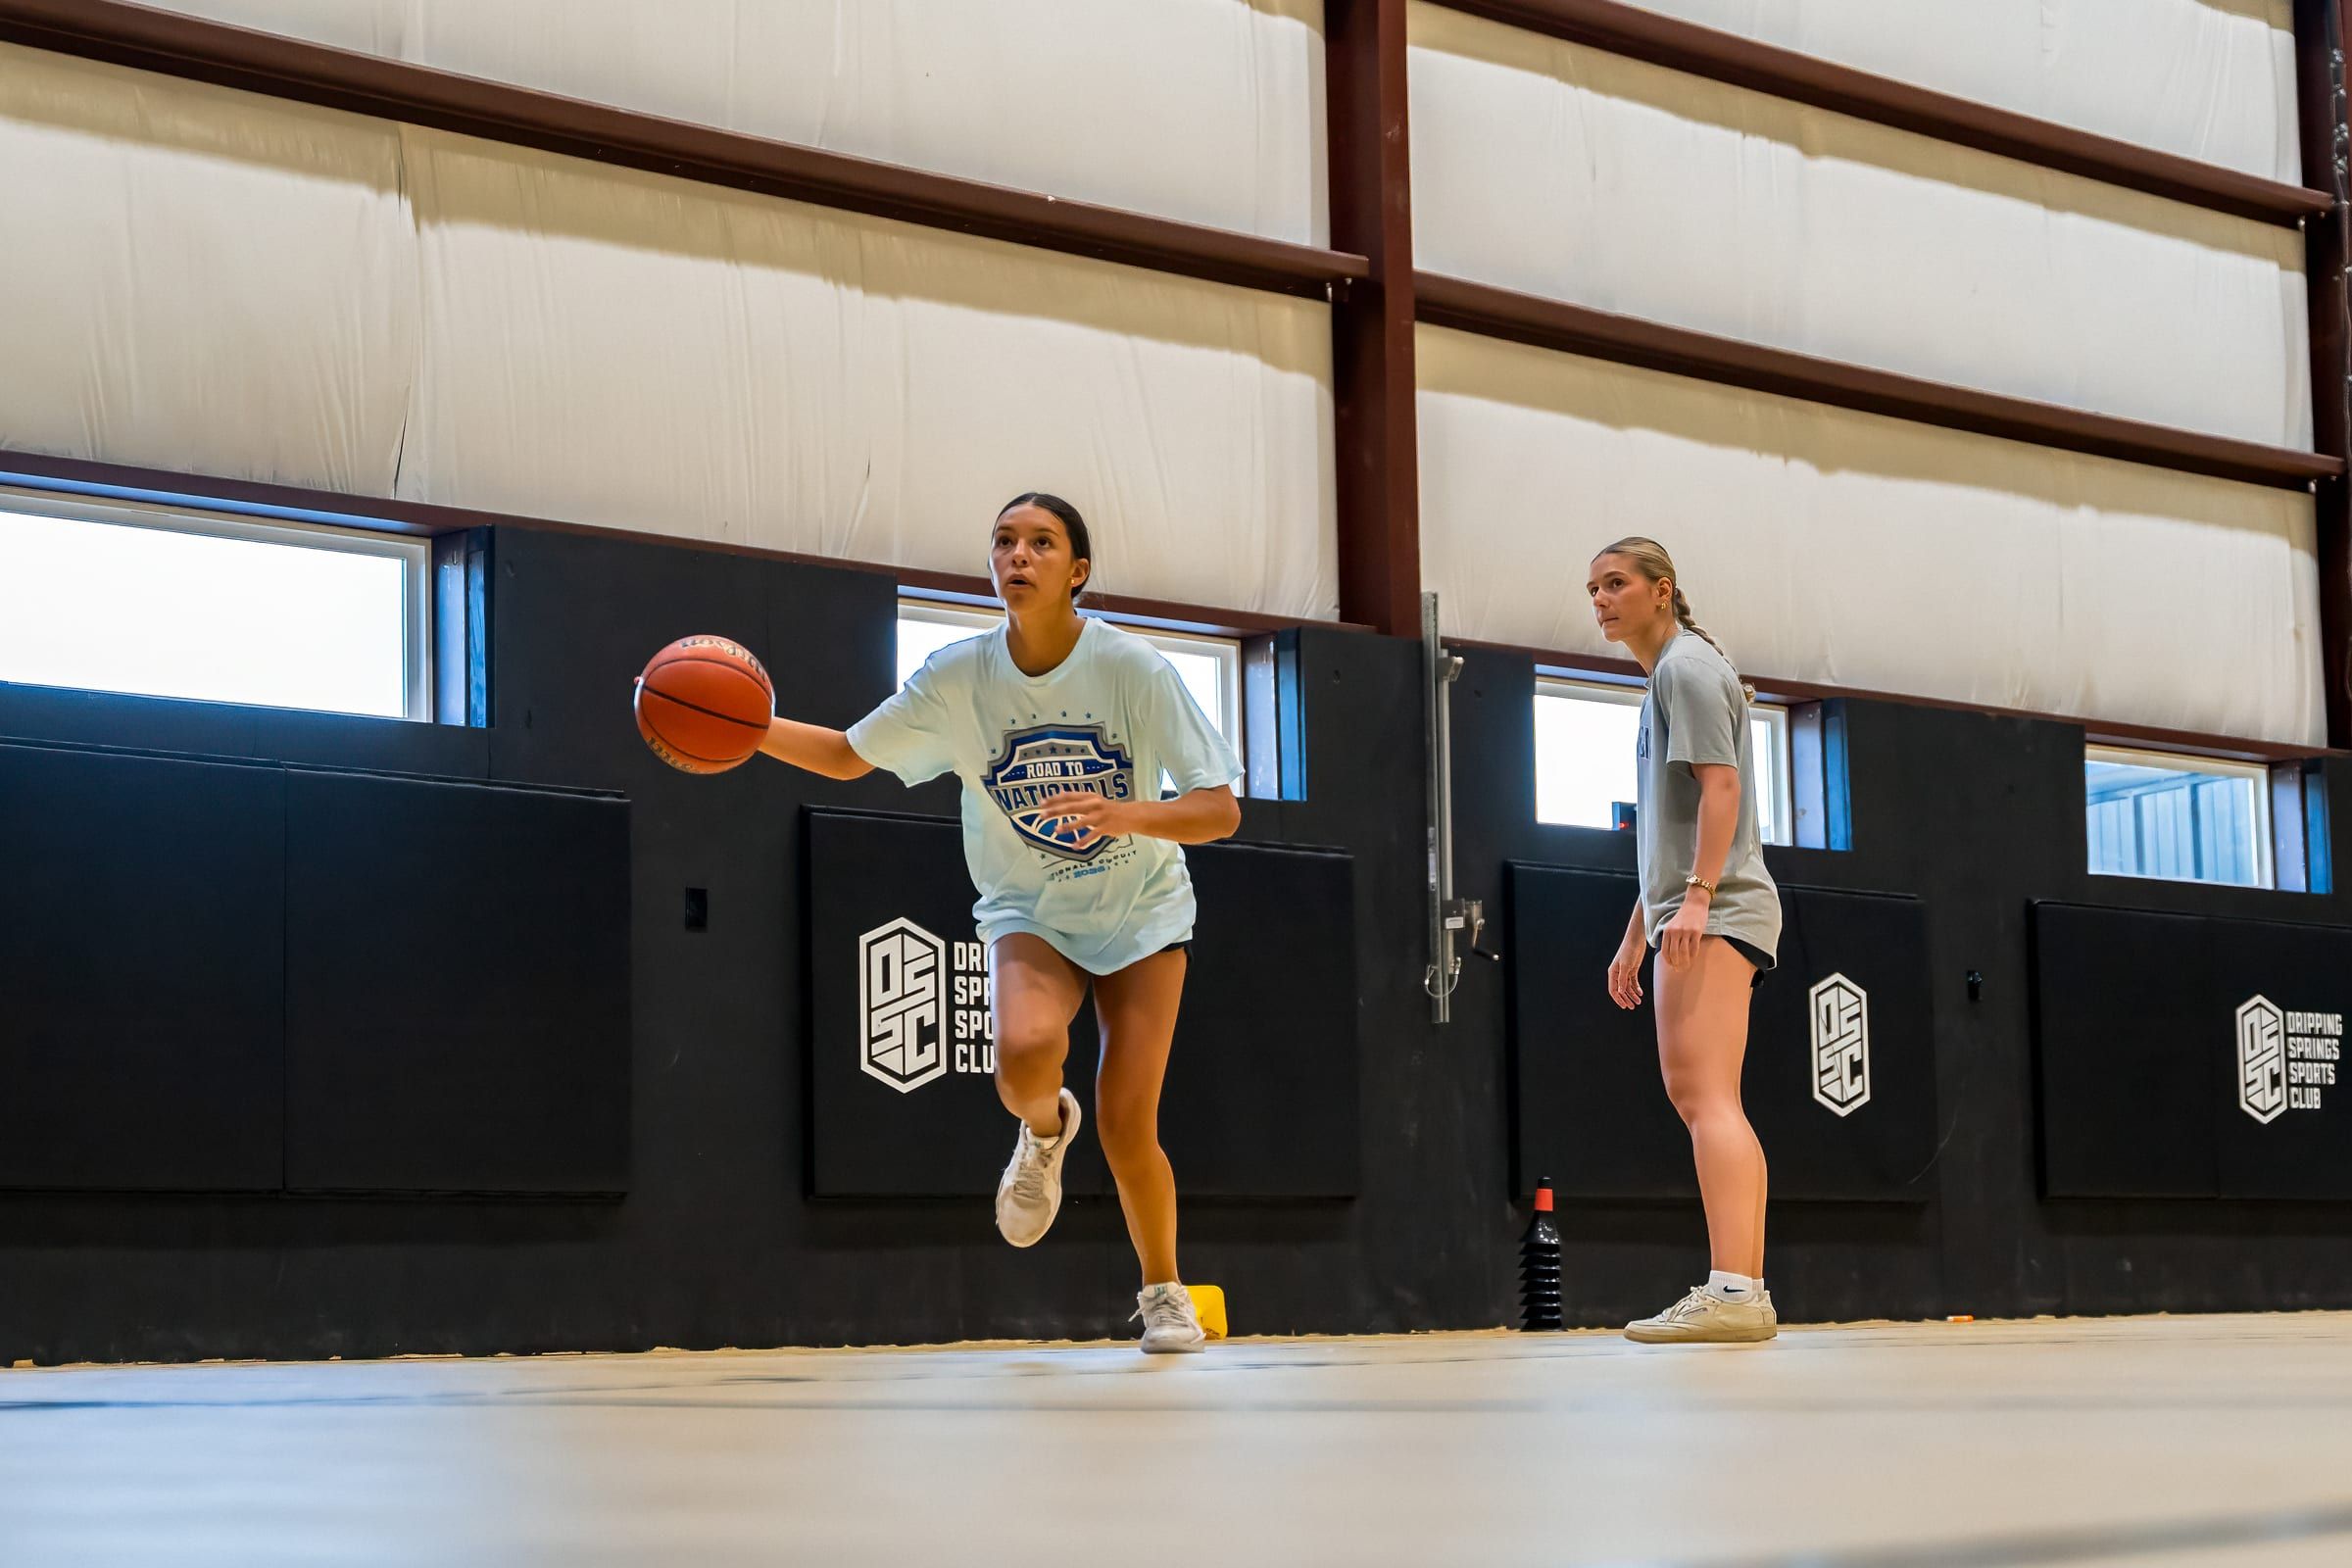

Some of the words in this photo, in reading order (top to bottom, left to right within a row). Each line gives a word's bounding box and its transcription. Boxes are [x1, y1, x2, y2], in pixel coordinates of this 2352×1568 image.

[1026, 761, 1060, 778] ROAD
[1065, 761, 1084, 776] TO
[2286, 1011, 2342, 1035] DRIPPING
[956, 1044, 995, 1074] CLU
[2288, 1037, 2339, 1060] SPRINGS
[2288, 1061, 2336, 1085] SPORTS
[2289, 1087, 2322, 1109] CLUB
